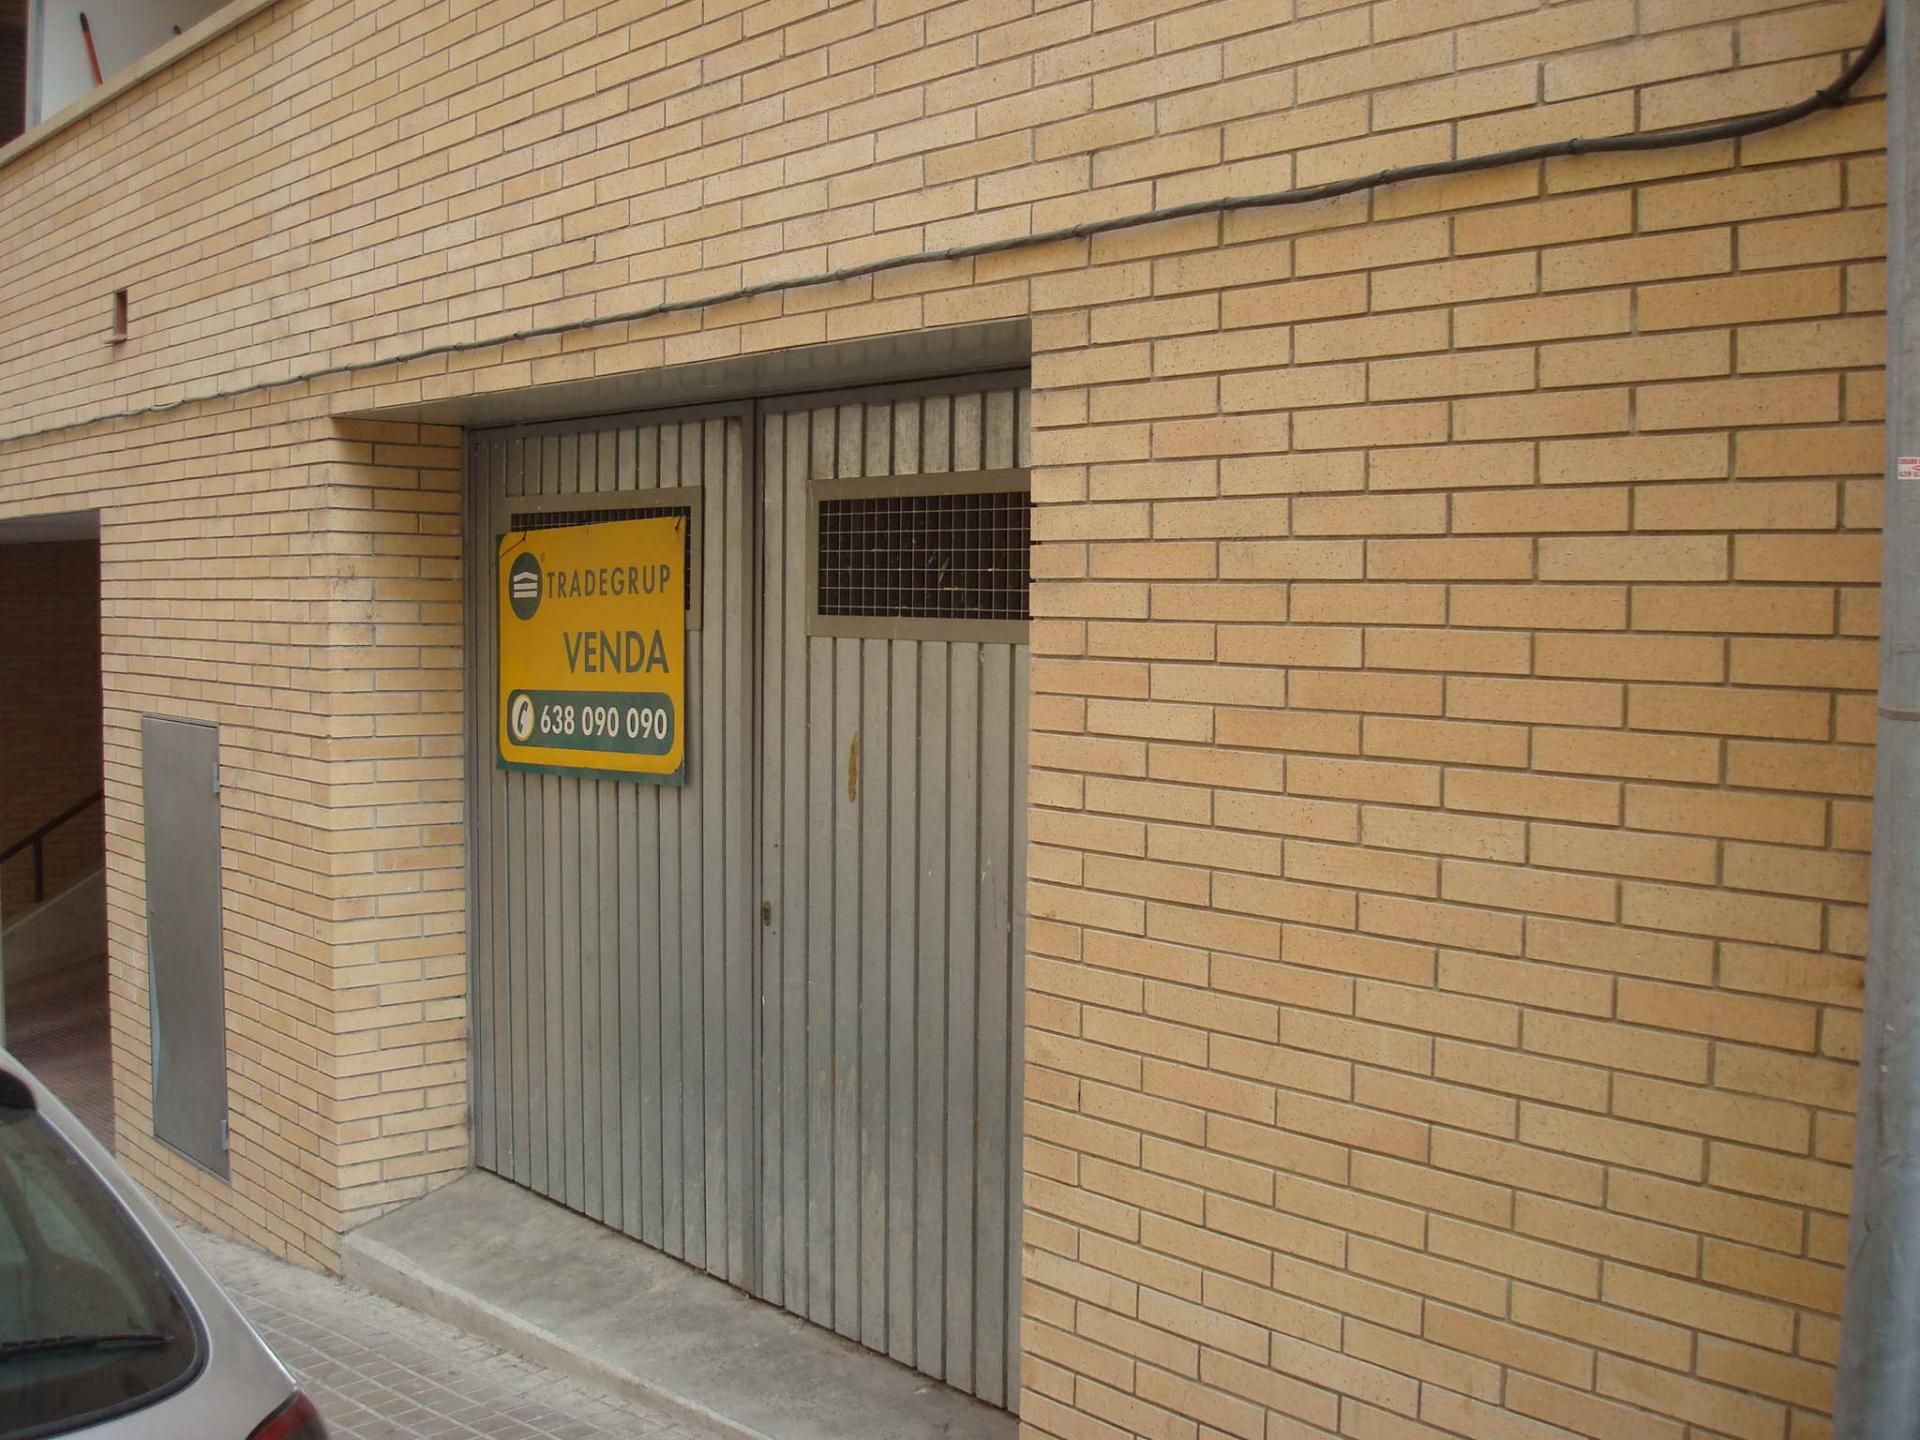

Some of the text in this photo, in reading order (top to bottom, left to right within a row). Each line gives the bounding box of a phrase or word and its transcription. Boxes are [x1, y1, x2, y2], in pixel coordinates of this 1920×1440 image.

[547, 564, 670, 598] TRADEGRUP
[563, 629, 670, 673] VENDA
[540, 705, 667, 740] 638 090 090
